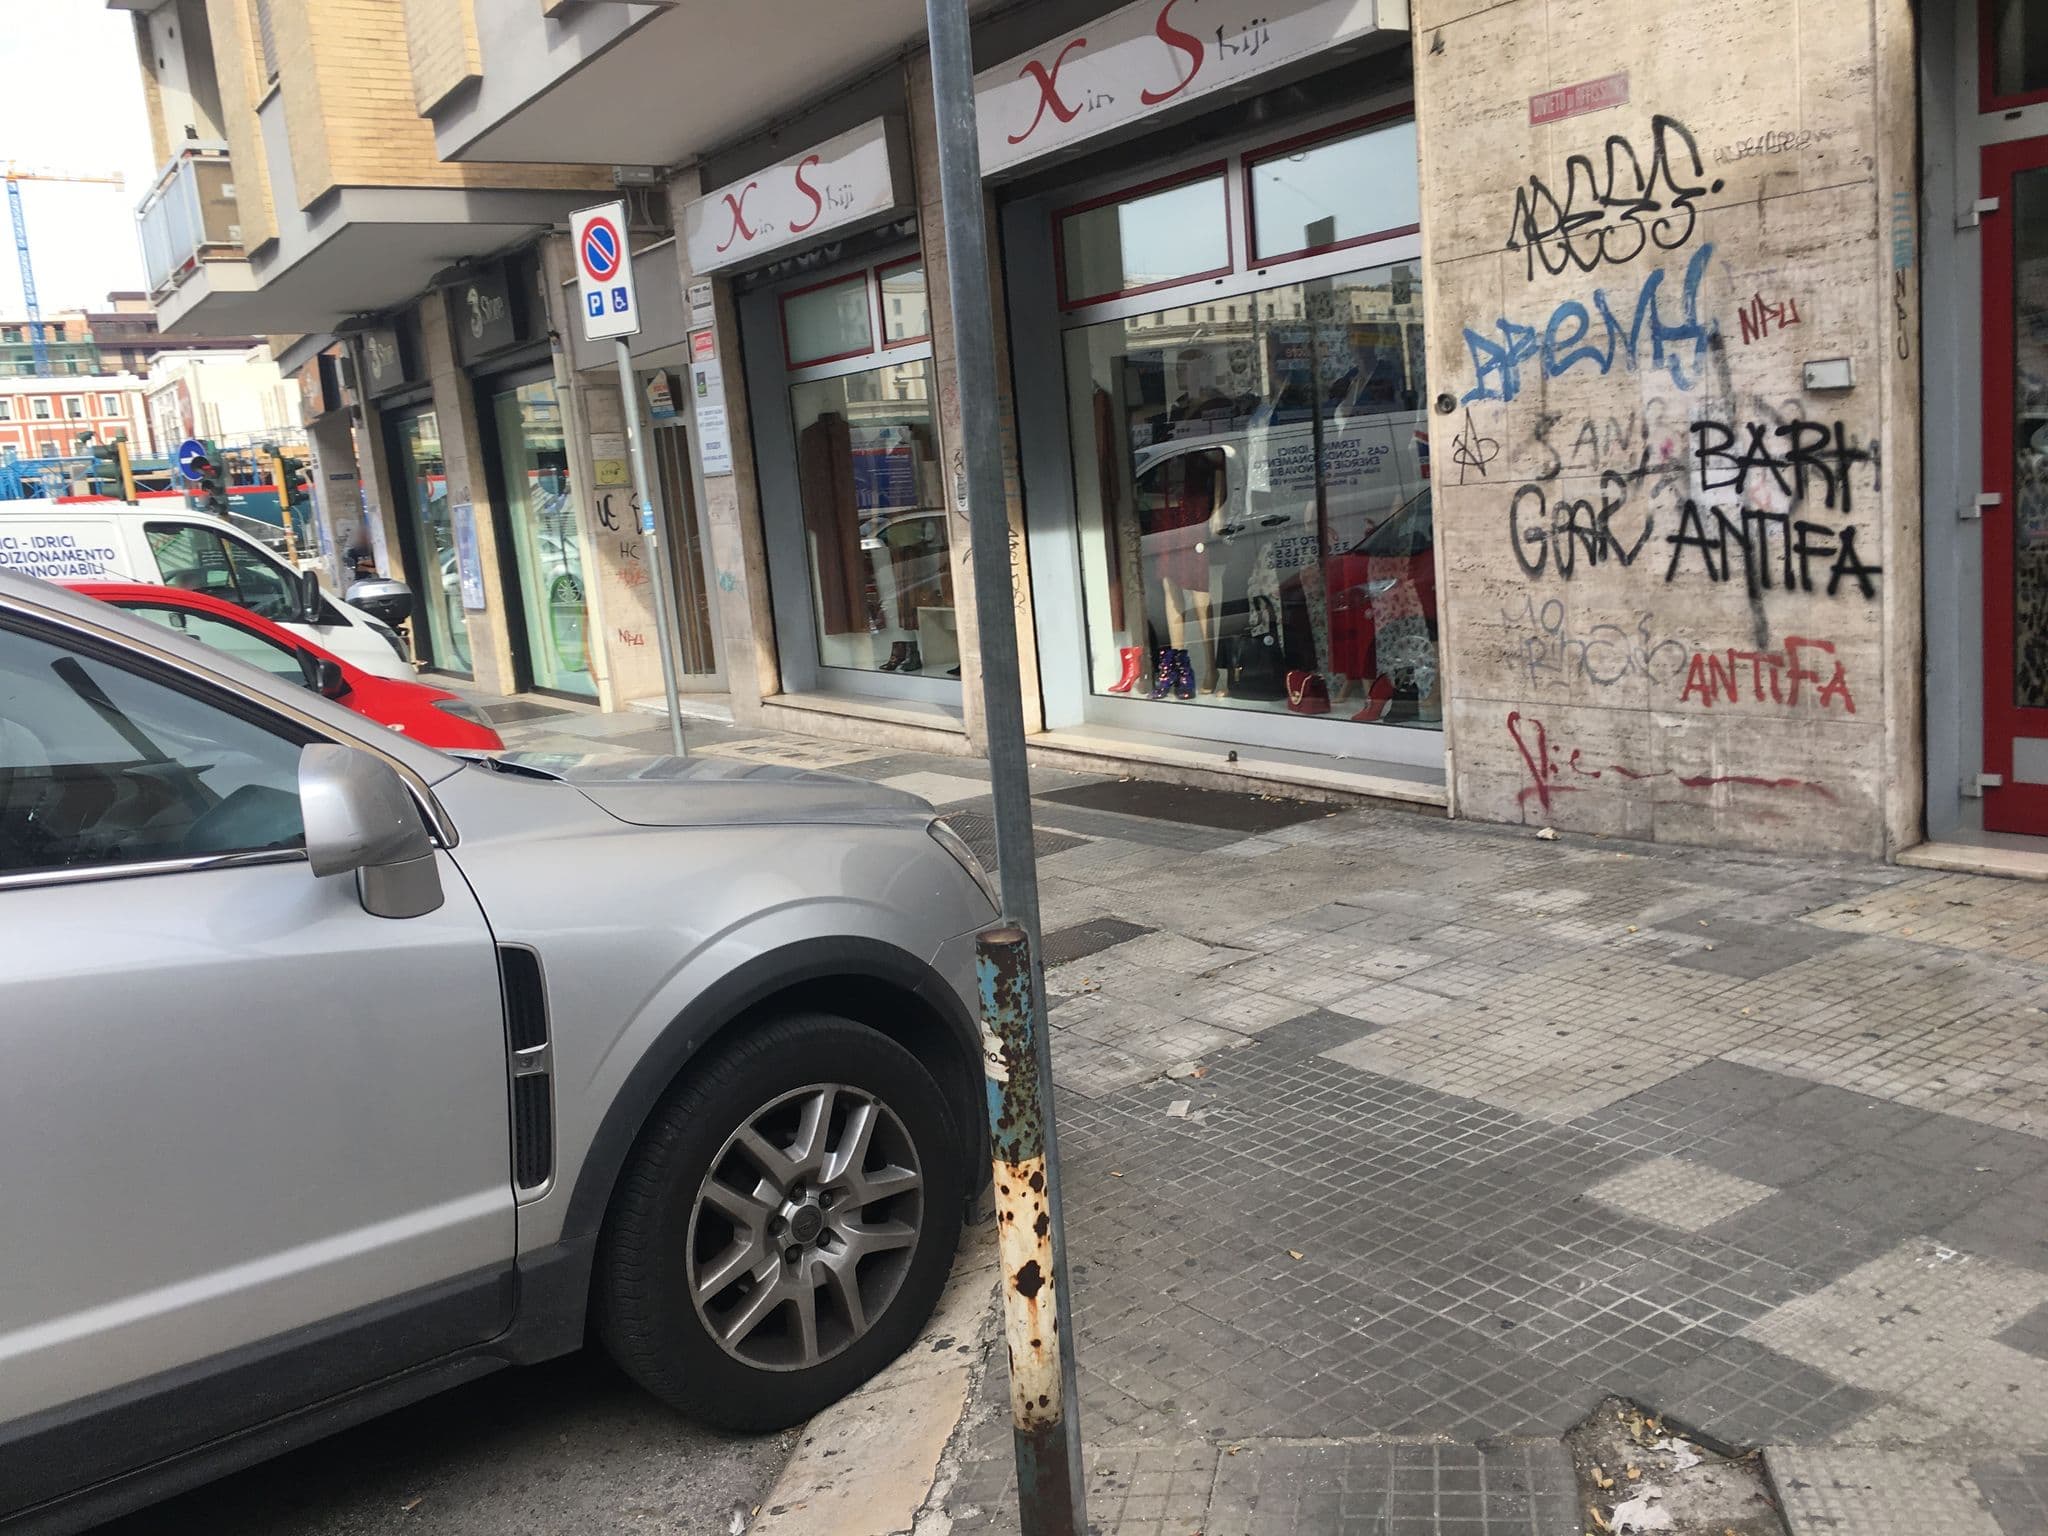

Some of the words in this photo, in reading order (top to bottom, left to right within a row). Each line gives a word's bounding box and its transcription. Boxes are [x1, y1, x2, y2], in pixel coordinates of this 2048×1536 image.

[1008, 38, 1115, 144] Xin
[716, 182, 775, 253] Xin
[589, 294, 602, 316] P
[0, 548, 115, 565] DIZIONAMENTO
[30, 535, 76, 549] IDRICI
[1665, 499, 1883, 602] ANTIFA
[1679, 637, 1856, 714] ANTIFA
